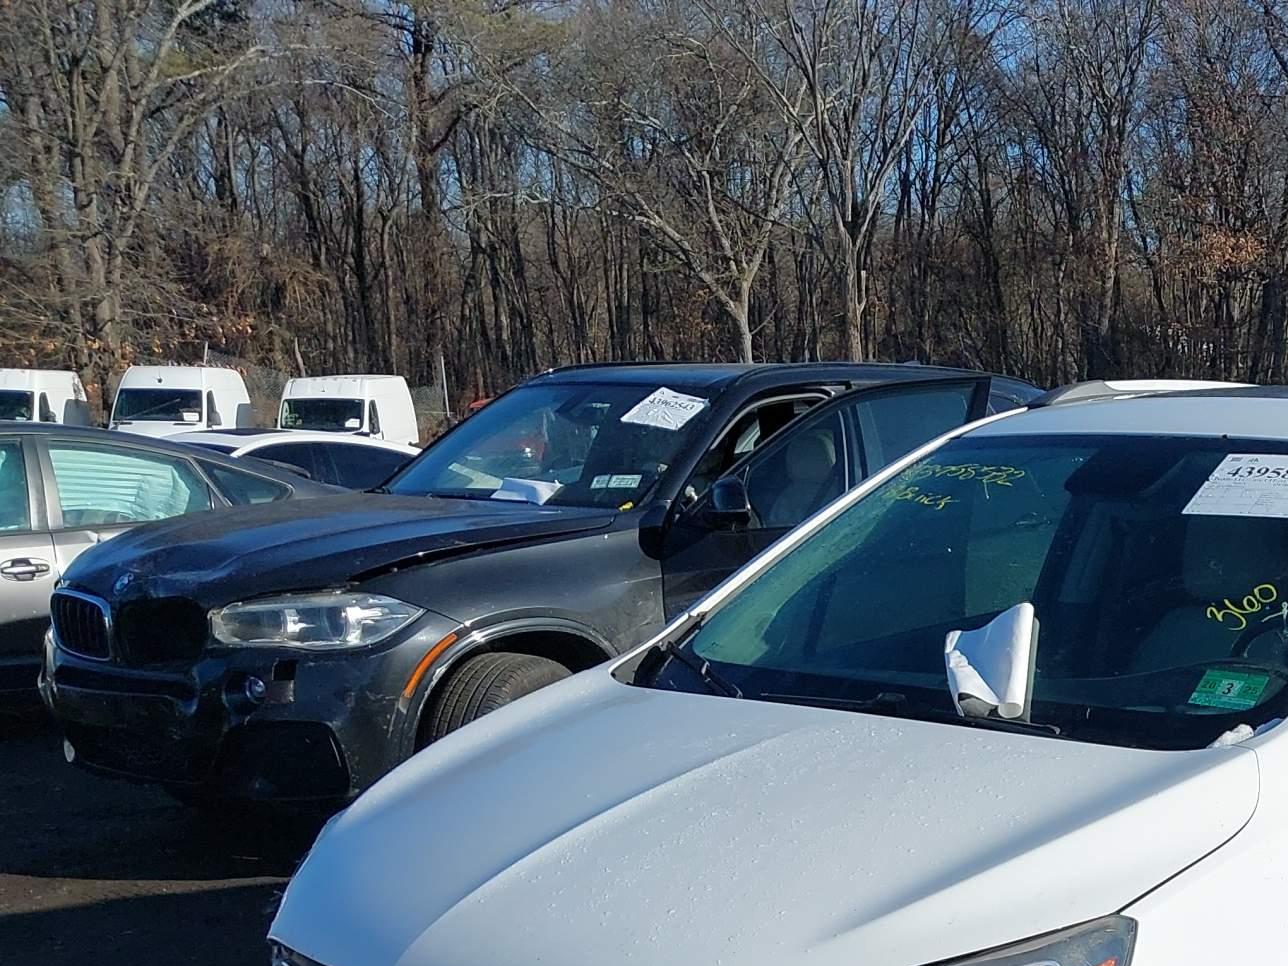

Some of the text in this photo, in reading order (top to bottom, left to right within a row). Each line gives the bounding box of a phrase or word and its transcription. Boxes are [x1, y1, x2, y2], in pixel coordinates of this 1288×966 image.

[1206, 584, 1278, 631] 360
[1201, 681, 1217, 689] 20
[1222, 682, 1234, 695] 3
